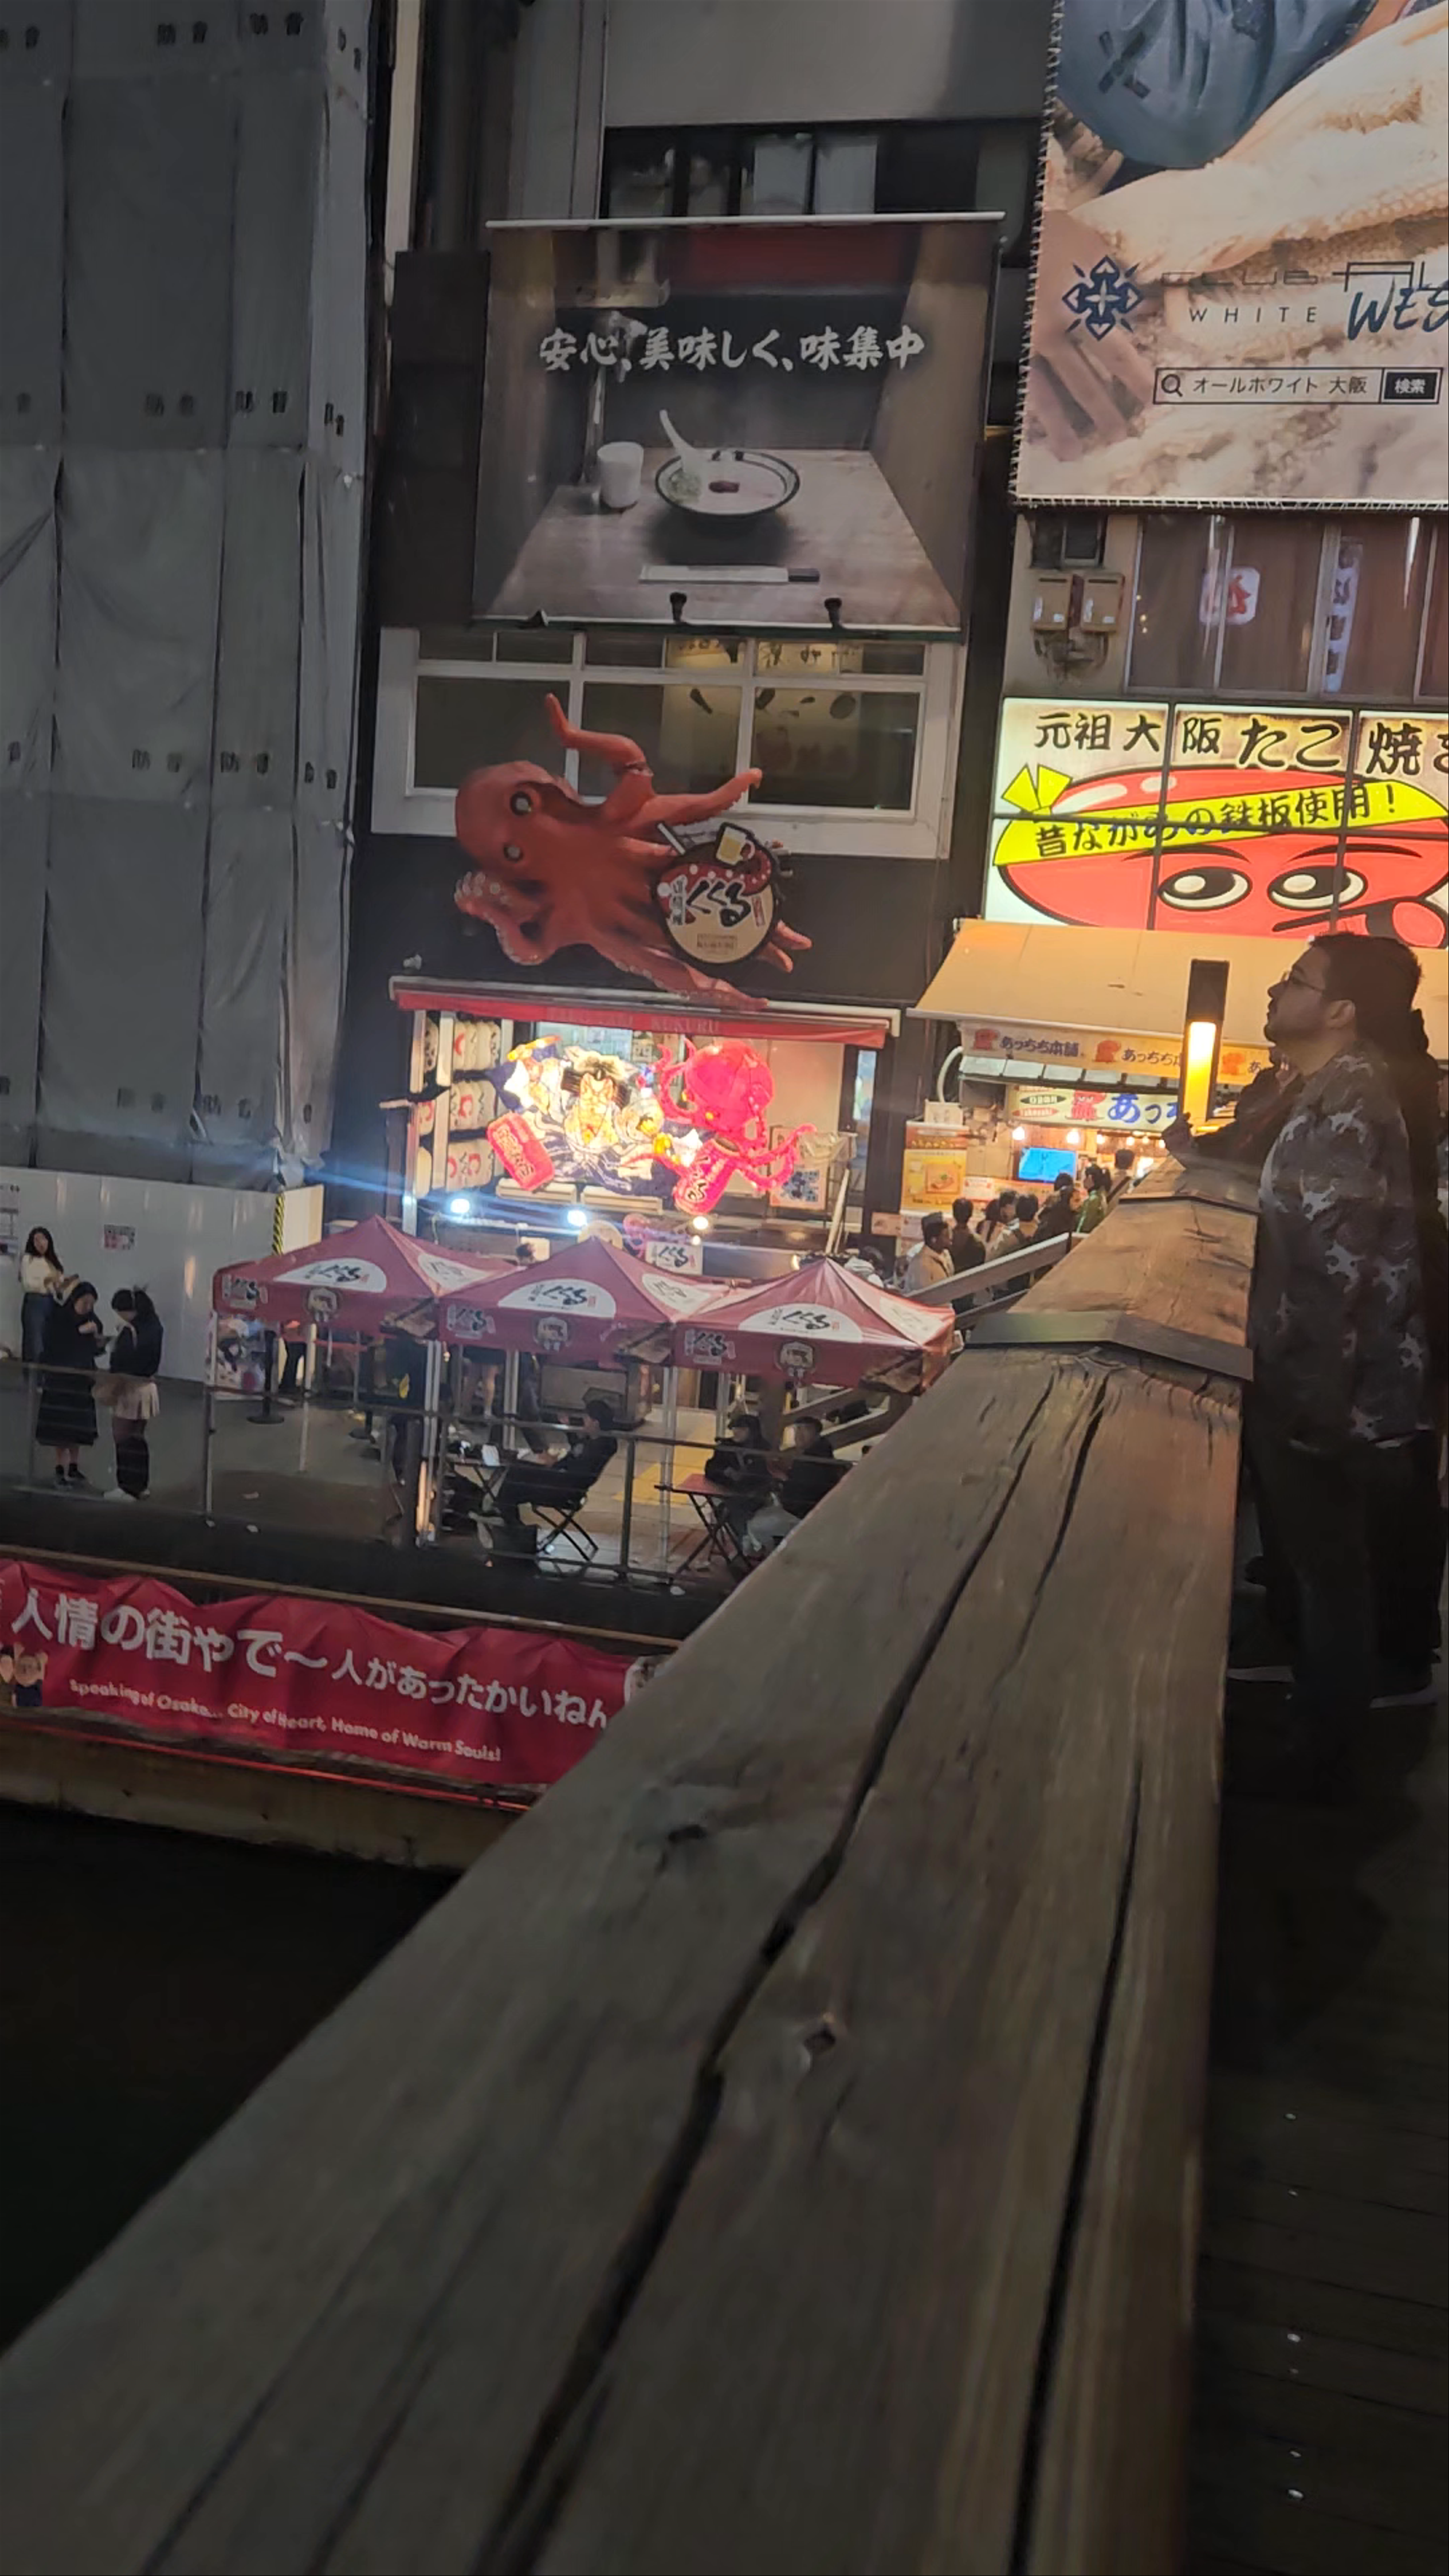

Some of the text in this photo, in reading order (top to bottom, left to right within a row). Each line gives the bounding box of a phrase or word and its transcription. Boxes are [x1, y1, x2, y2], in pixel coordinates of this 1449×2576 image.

[1189, 306, 1317, 323] WHITE
[539, 325, 925, 372] 安心、美味しく、味集中
[1192, 376, 1369, 395] オールホワイト 大阪
[227, 1702, 260, 1724] City
[263, 1708, 277, 1724] of
[331, 1716, 378, 1739] Home
[381, 1727, 400, 1744] of
[402, 1730, 452, 1752] Warm
